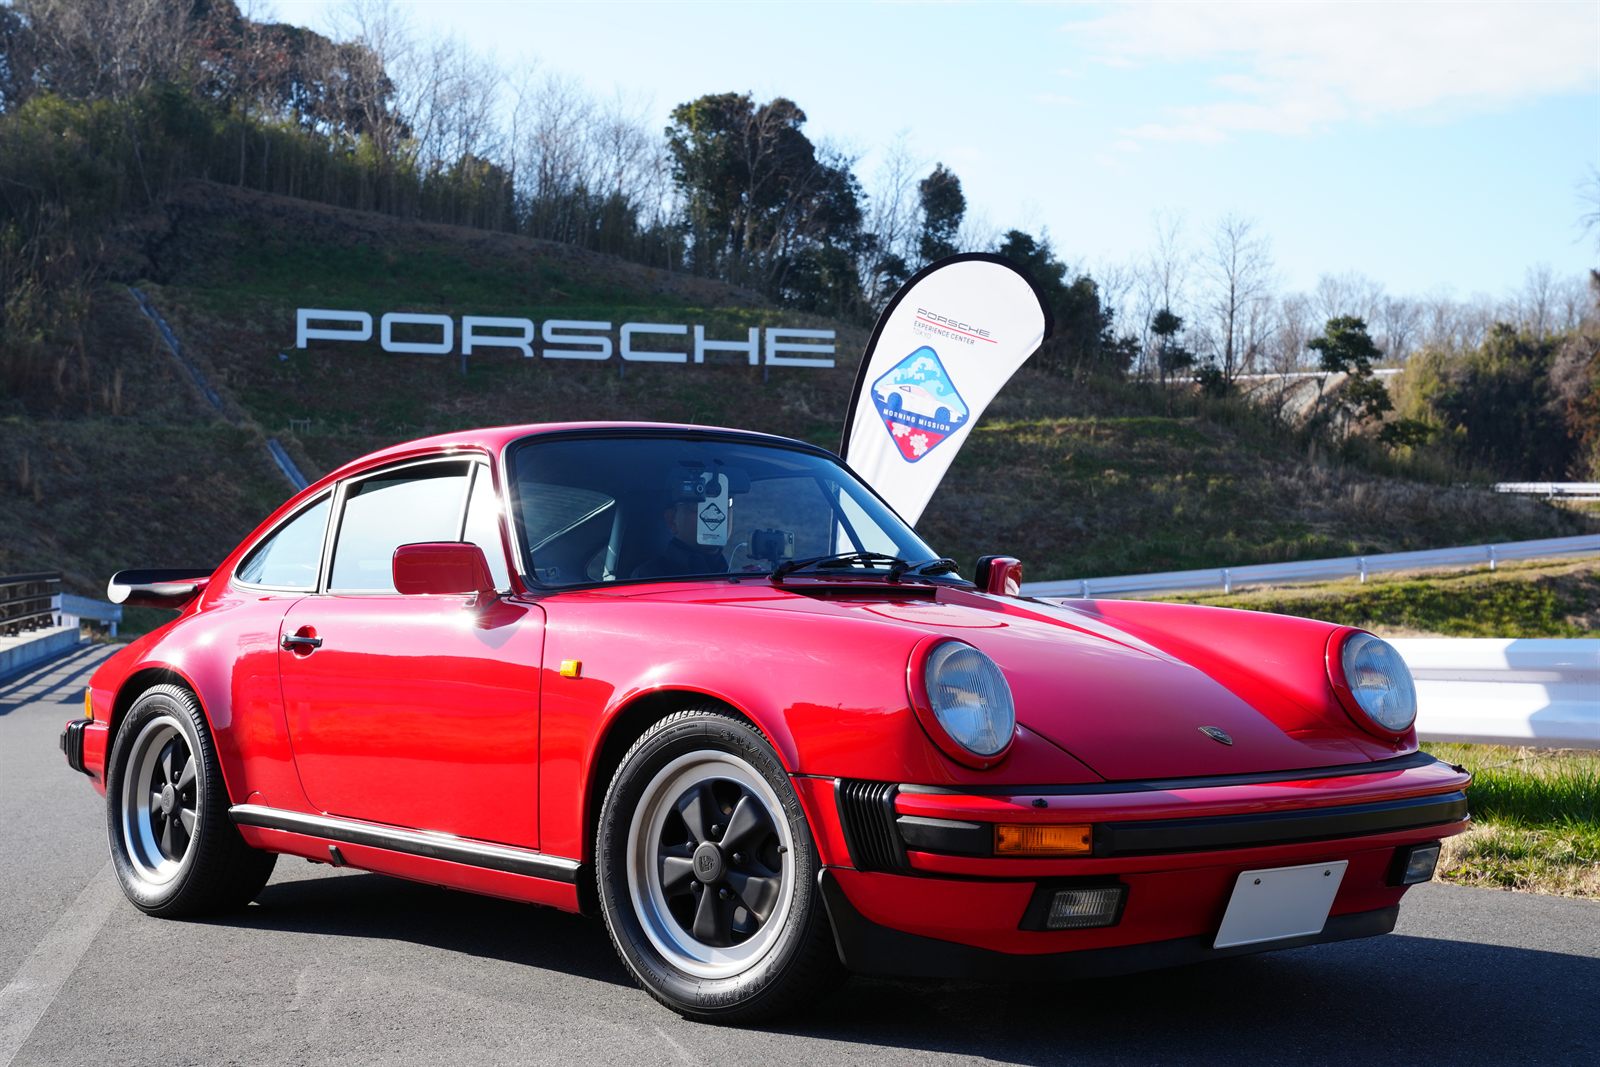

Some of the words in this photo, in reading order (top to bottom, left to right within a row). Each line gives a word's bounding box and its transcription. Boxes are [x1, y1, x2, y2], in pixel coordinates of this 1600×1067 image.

[913, 320, 950, 338] EXPERIENCE
[950, 332, 975, 345] CENTER
[913, 327, 932, 339] TOKYO
[917, 308, 991, 338] PORSCHE
[297, 308, 836, 368] PORSCHE
[883, 408, 916, 423] MORNING
[918, 418, 951, 431] MISSION
